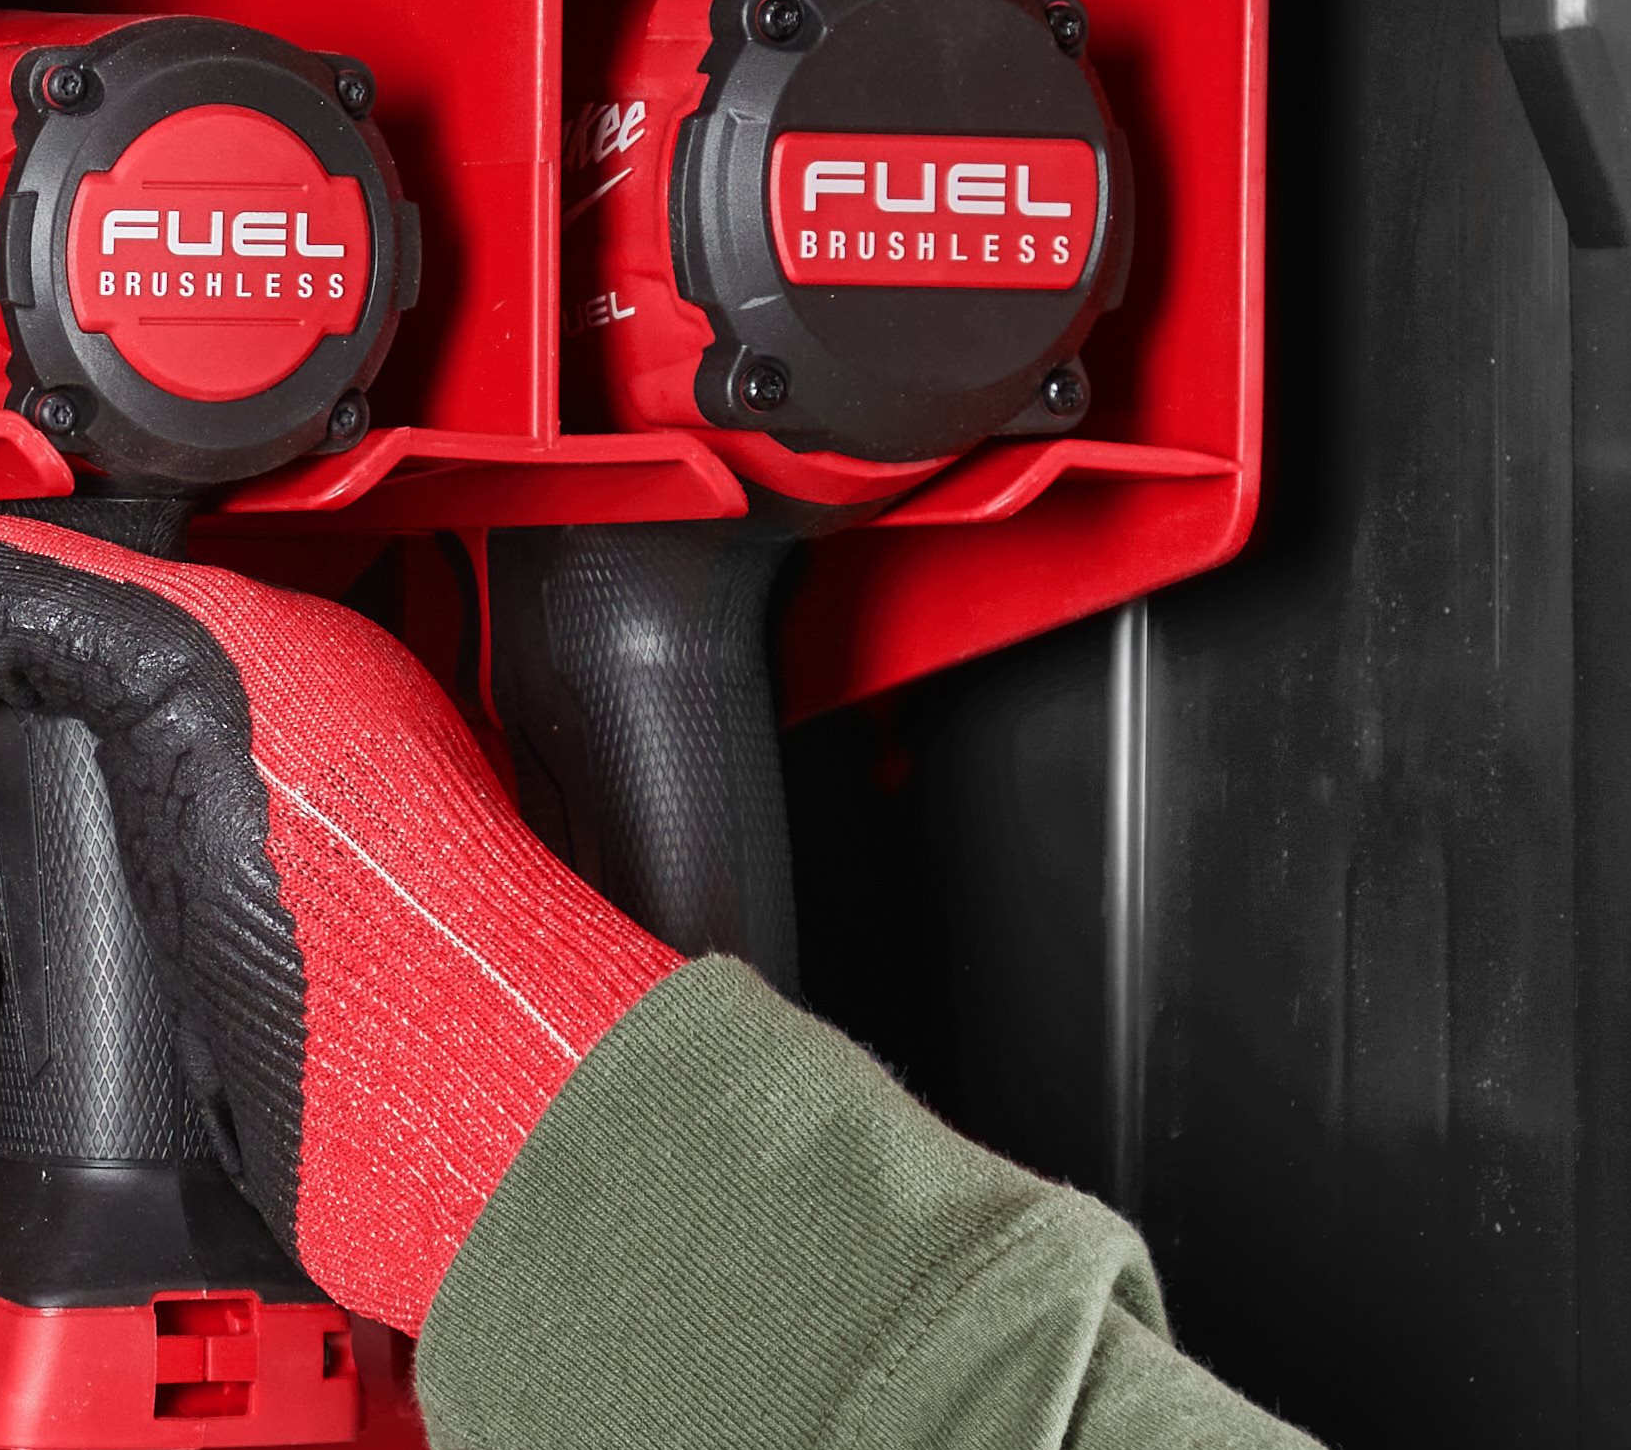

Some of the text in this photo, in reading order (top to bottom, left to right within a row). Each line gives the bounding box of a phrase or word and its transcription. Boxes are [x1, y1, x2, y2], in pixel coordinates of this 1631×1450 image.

[803, 160, 1072, 218] FUEL
[102, 209, 346, 258] FUEL
[799, 229, 1071, 265] BRUSHLESS
[99, 270, 346, 300] BRUSHLESS
[563, 291, 636, 333] UEL
